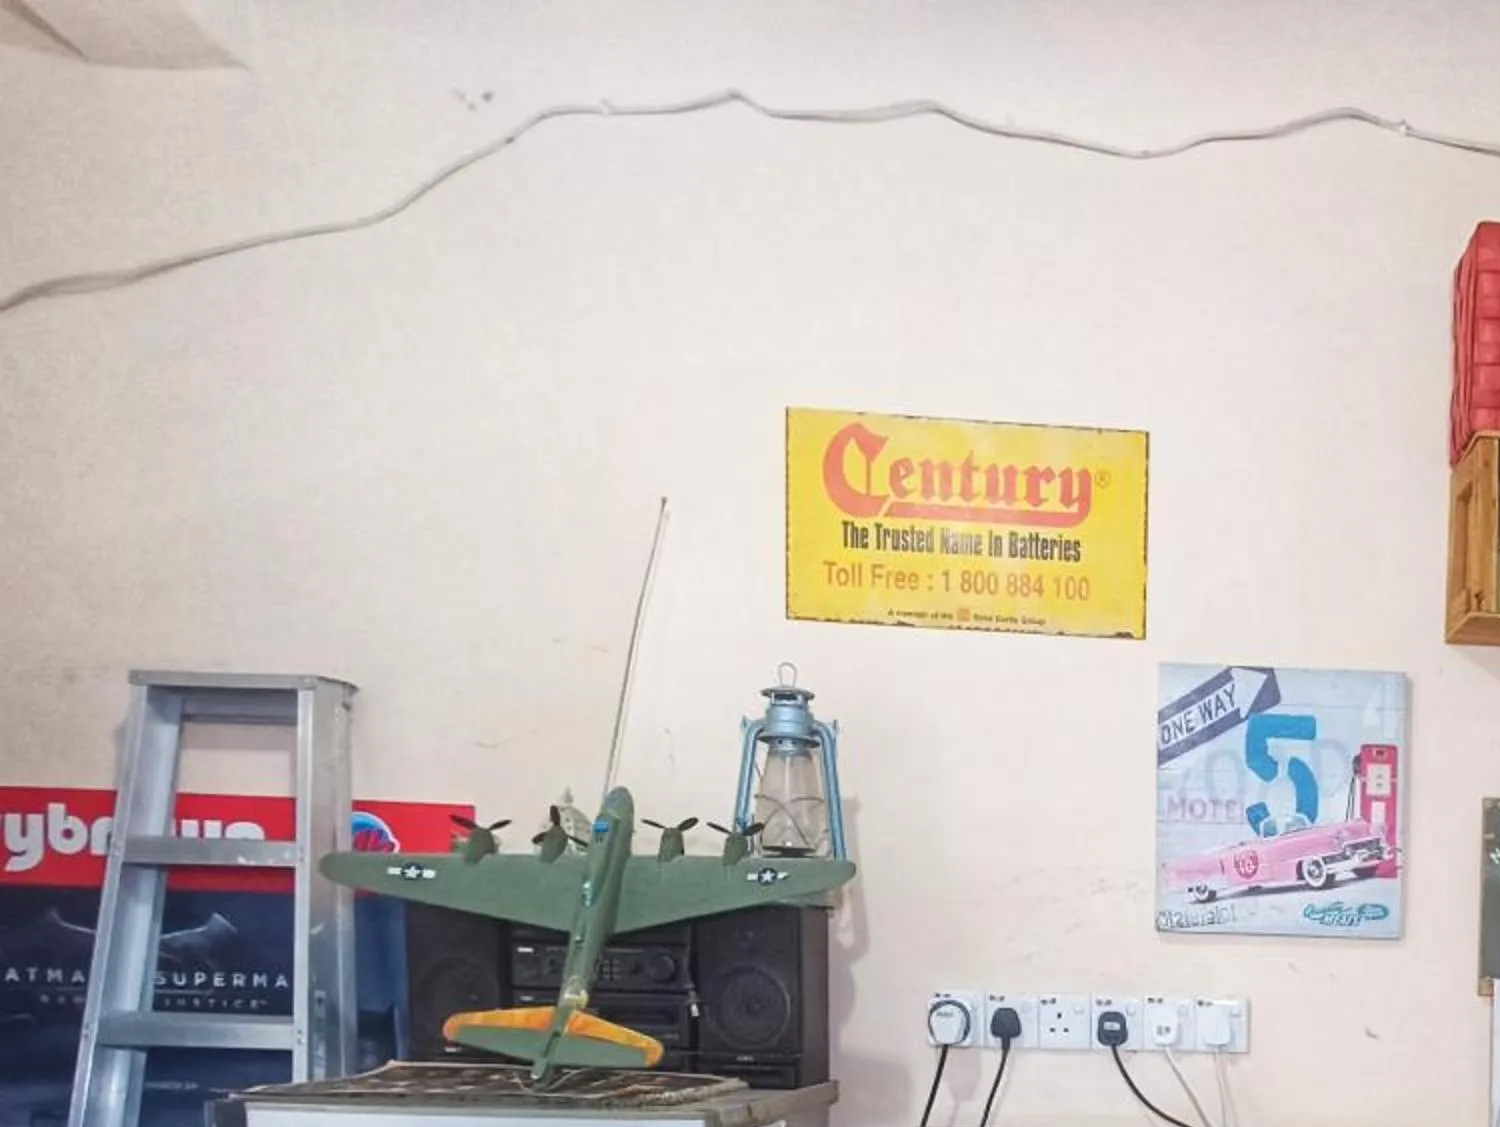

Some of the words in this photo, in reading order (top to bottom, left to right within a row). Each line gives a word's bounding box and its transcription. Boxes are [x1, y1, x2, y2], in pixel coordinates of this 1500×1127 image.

[821, 422, 1092, 528] Century
[842, 521, 869, 549] The
[874, 523, 934, 553] Trusted
[940, 528, 982, 555] Name
[988, 530, 1003, 557] In
[1008, 531, 1081, 562] Batteries
[823, 561, 863, 588] Toll
[871, 563, 920, 591] Free
[941, 569, 951, 592] 1
[959, 570, 999, 595] 800
[1006, 573, 1045, 599] 884
[1053, 576, 1090, 601] 100
[1161, 710, 1196, 745] ONE
[1199, 683, 1236, 725] WAY
[1245, 712, 1319, 838] 5
[5, 967, 87, 984] ATMA
[152, 972, 289, 989] SUPERMA
